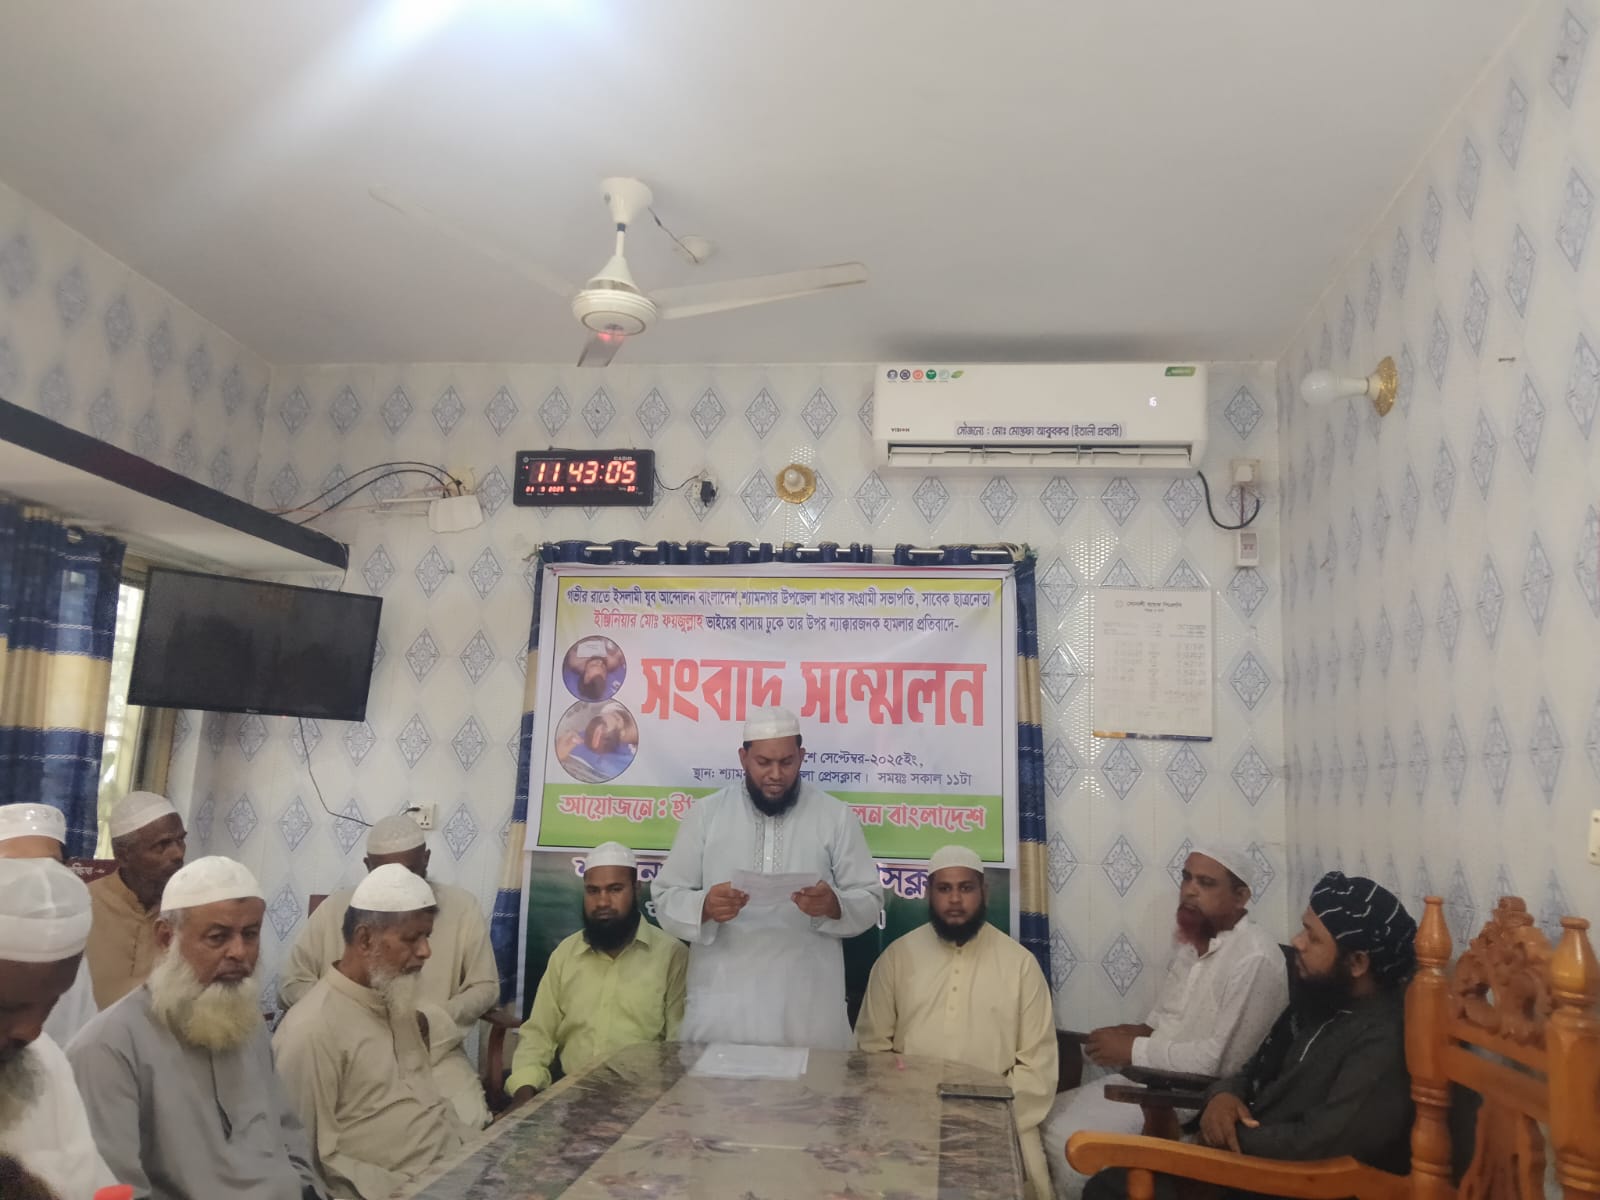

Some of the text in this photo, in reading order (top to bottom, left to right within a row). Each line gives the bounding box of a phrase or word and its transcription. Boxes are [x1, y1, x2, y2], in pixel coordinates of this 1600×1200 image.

[567, 586, 588, 604] গভীর
[590, 590, 610, 604] রাতে
[613, 586, 642, 605] ইসলামী
[644, 590, 657, 607] যুব
[658, 590, 696, 606] আন্দোলন
[781, 588, 817, 606] উপজেলা
[819, 591, 844, 606] শাখার
[847, 587, 877, 606] সংগ্রামী
[922, 592, 951, 607] সাবেক
[953, 592, 990, 607] ছাত্রনেতা
[593, 608, 638, 629] ইঞ্জিনিয়ার
[705, 613, 737, 631] ভাইয়ের
[739, 616, 763, 631] বাসায়
[765, 617, 784, 634] ঢুকে
[787, 617, 804, 631] তার
[806, 613, 827, 631] উপর
[883, 617, 914, 633] হামলার
[641, 658, 987, 726] সংবাদ সম্মেলন
[910, 773, 942, 786] সকাল
[946, 772, 972, 787] ১১টা
[886, 805, 985, 831] বাংলাদেশ
